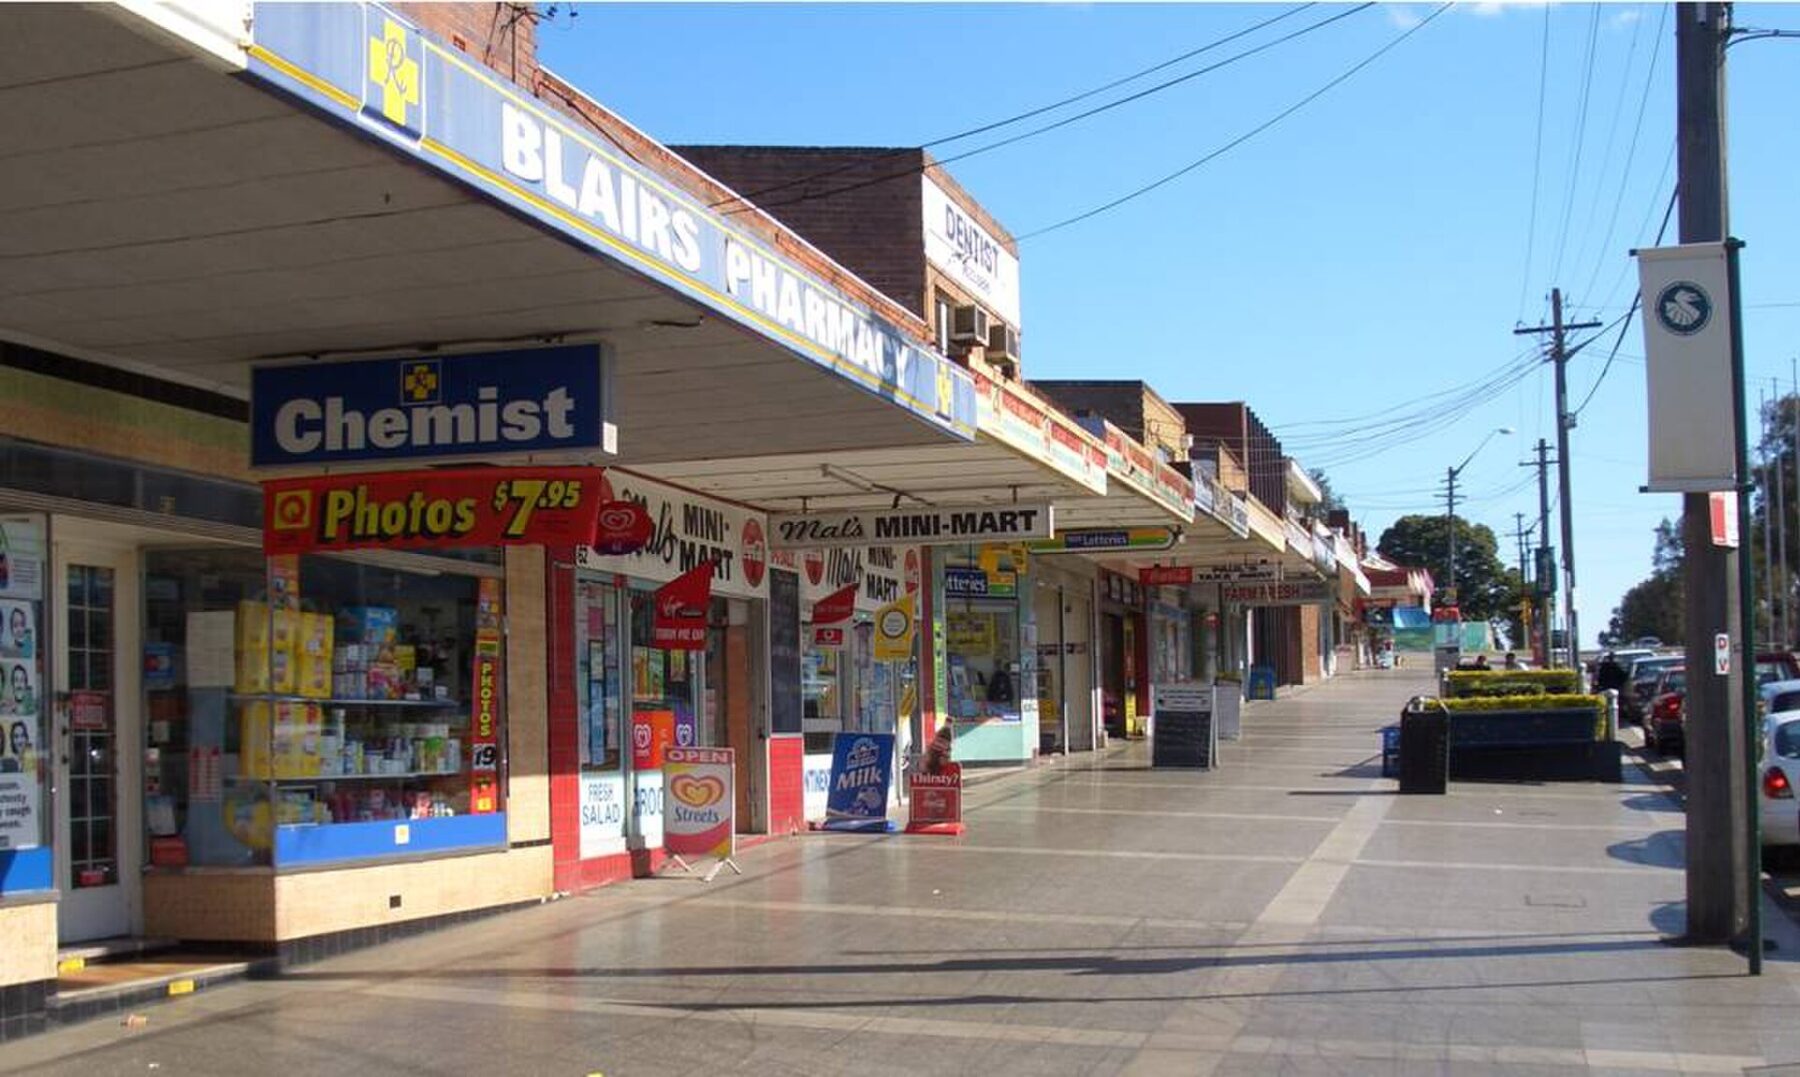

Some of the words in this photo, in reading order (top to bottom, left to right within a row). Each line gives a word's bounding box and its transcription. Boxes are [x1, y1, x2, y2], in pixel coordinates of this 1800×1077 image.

[502, 101, 701, 272] BLAIRS
[725, 238, 913, 388] PHARMACY
[945, 203, 999, 279] DENTIST
[274, 386, 576, 453] Chemist
[324, 484, 477, 541] Photos
[779, 516, 864, 541] Mal's
[874, 509, 1038, 538] MINI-MART
[480, 662, 492, 737] PHOTOS
[667, 750, 729, 763] OPEN
[588, 783, 614, 801] FRESH
[837, 766, 882, 791] Milk
[911, 773, 959, 785] Thirsty?
[582, 803, 621, 826] SALAD
[674, 805, 720, 824] Streets
